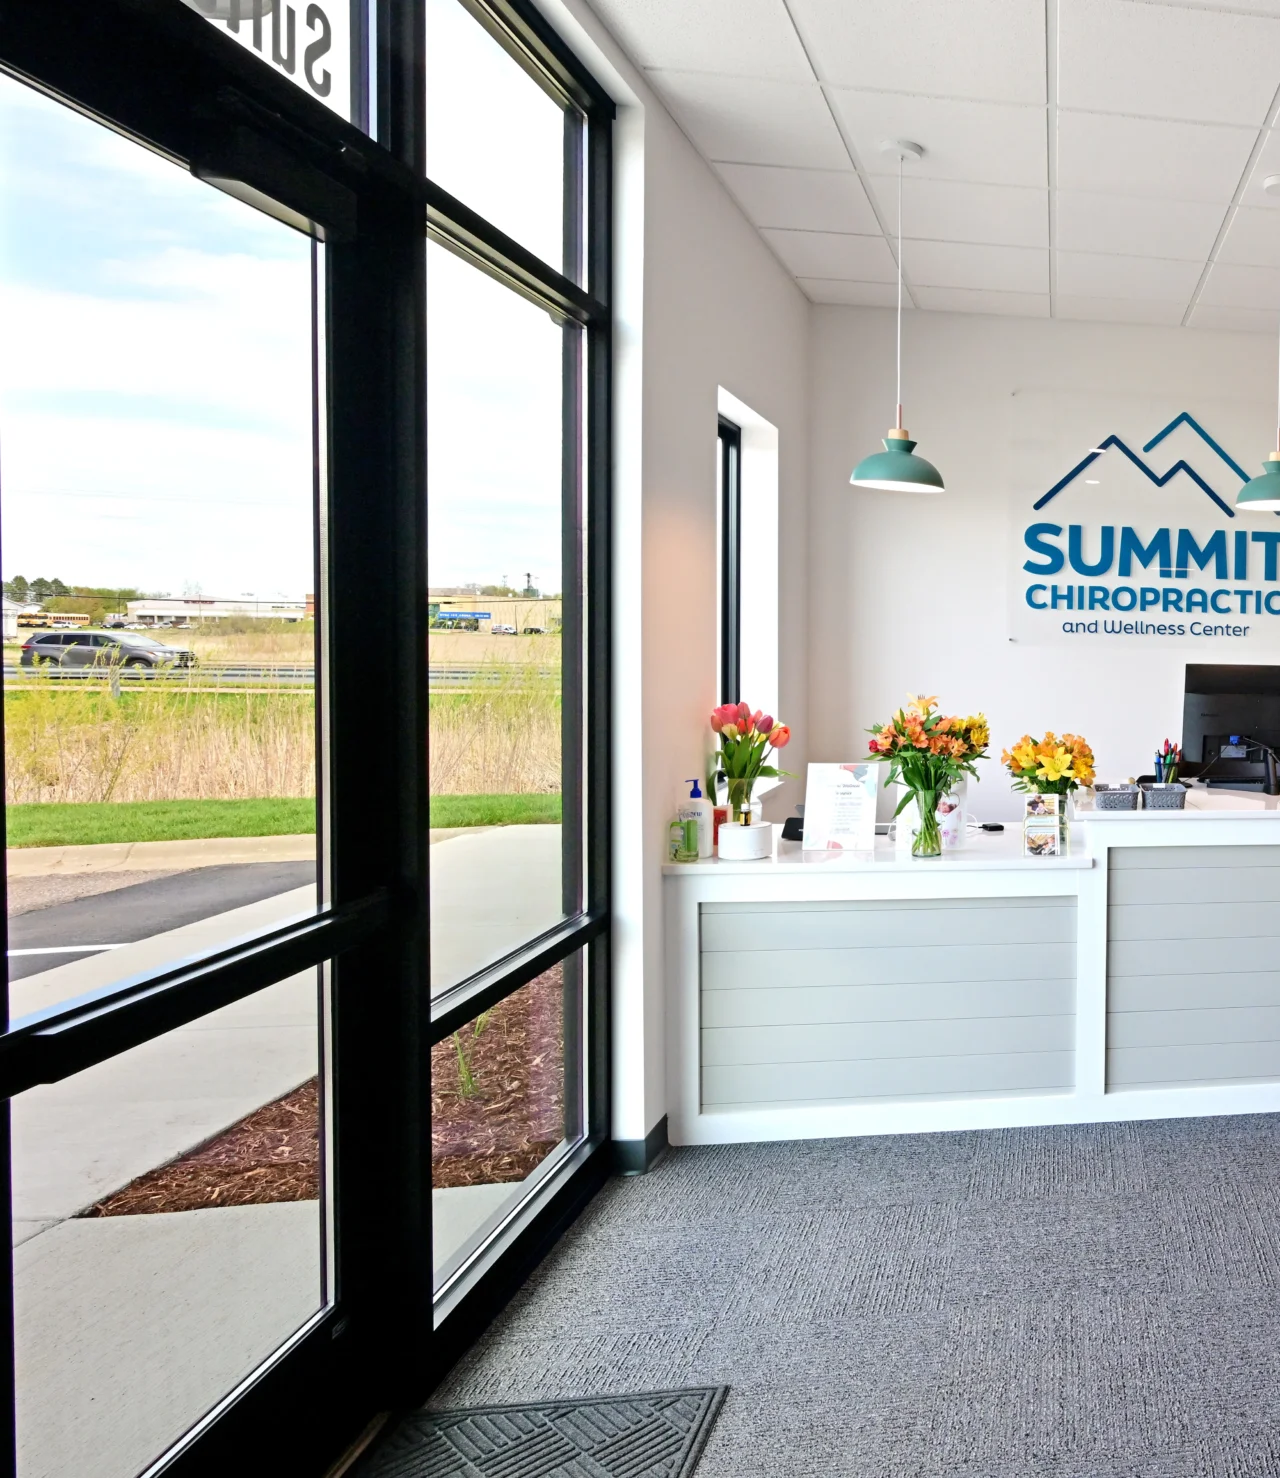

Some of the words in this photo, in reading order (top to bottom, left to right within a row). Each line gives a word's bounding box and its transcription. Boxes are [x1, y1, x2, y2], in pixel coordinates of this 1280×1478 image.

[1062, 620, 1098, 634] and
[1103, 620, 1186, 636] Wellness
[1189, 622, 1251, 637] Center
